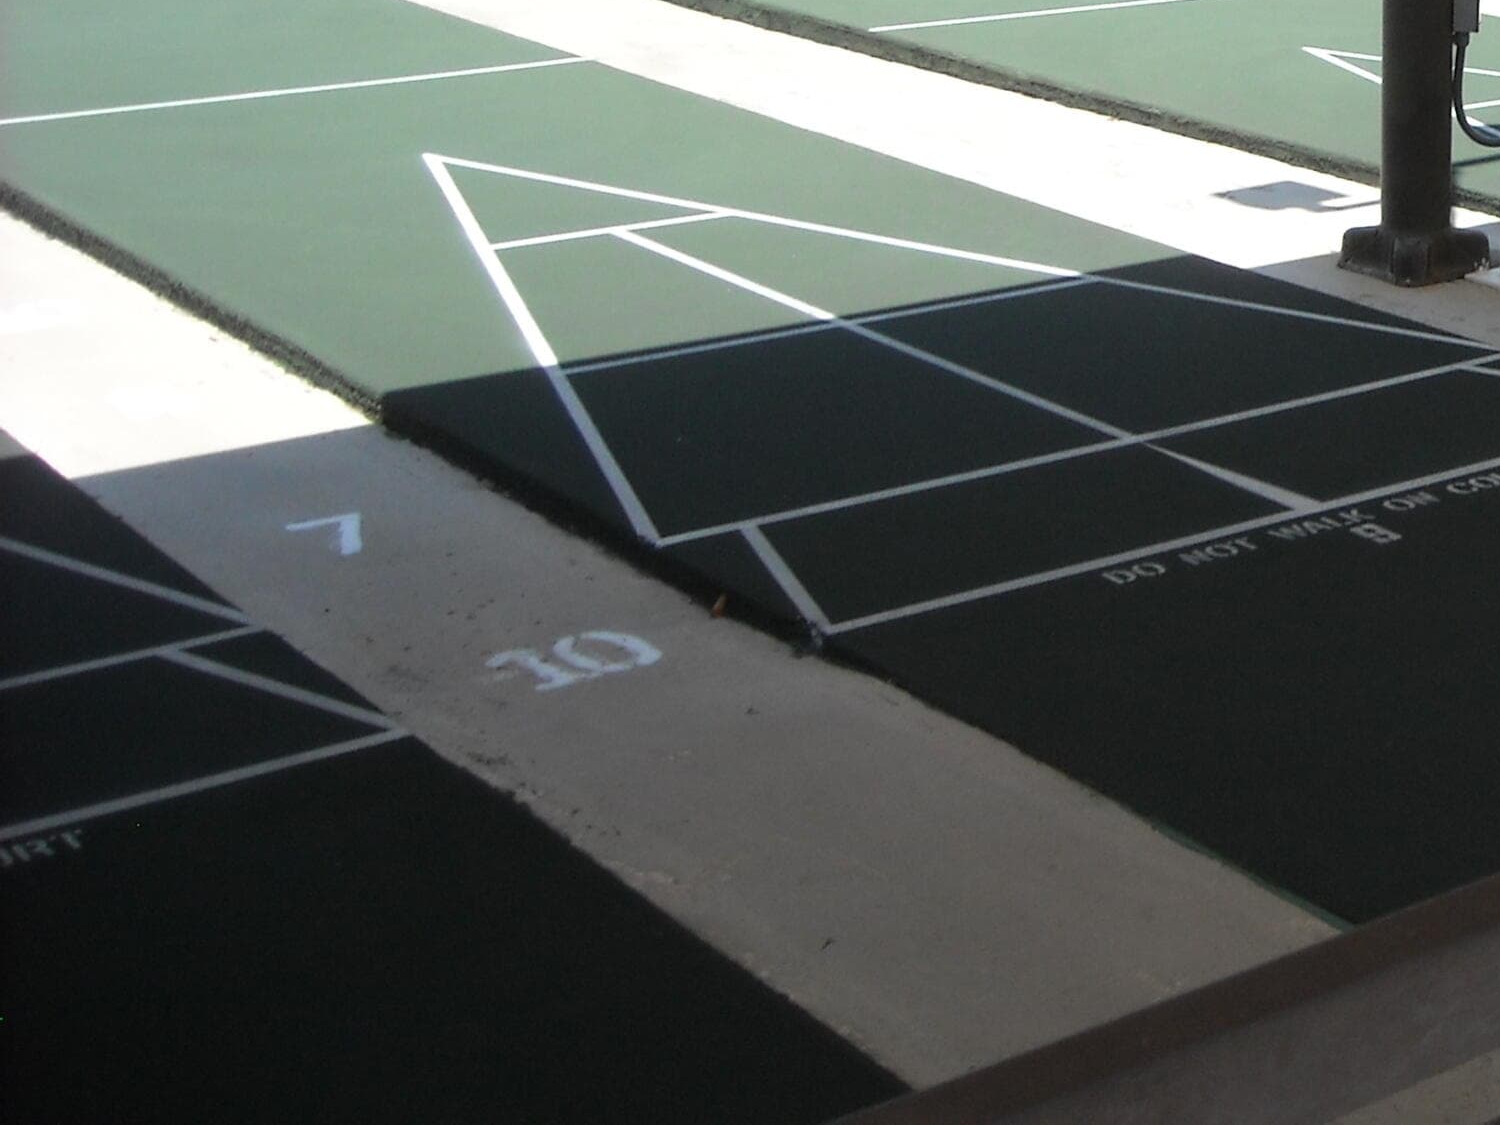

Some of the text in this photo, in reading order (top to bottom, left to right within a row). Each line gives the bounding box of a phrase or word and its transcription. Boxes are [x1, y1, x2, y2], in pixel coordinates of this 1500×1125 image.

[286, 512, 363, 556] 7
[1101, 561, 1167, 585] DO
[1178, 536, 1259, 566] NOT
[1267, 508, 1377, 542] WALK
[1382, 490, 1441, 512] ON
[485, 630, 664, 692] 10
